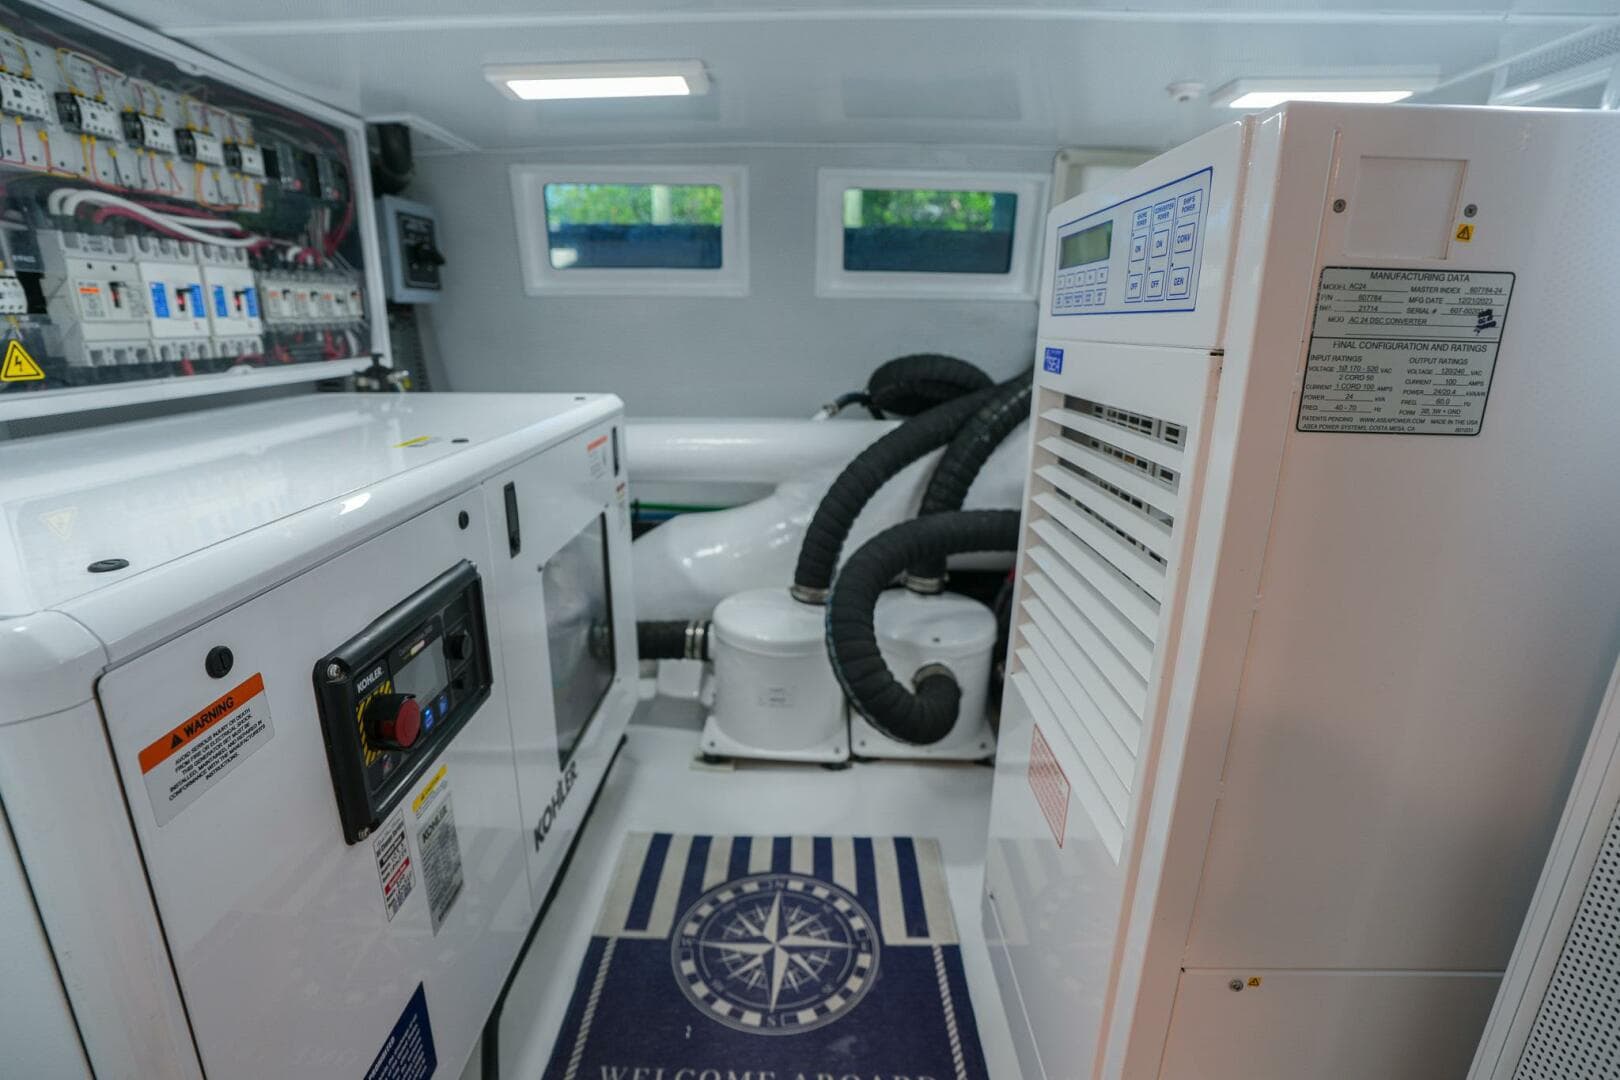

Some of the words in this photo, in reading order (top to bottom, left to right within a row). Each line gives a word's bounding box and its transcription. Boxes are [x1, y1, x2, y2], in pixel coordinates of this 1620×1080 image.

[1156, 240, 1163, 248] ON
[1177, 233, 1191, 244] CONV
[1151, 280, 1159, 288] OFF
[1370, 271, 1446, 281] MANUFACTURING
[1446, 274, 1470, 282] DATA
[1332, 340, 1358, 348] FINAL
[1359, 341, 1430, 350] CONFIGURATION
[1431, 343, 1449, 351] AND
[1450, 344, 1487, 352] RATINGS
[357, 666, 382, 693] KOHLER
[184, 697, 233, 736] WARNING
[175, 760, 190, 772] FROM
[191, 751, 201, 761] FIRE
[203, 745, 209, 753] OR
[210, 726, 236, 747] ELECTRICAL
[176, 751, 190, 764] AVOID
[191, 736, 212, 753] SERIOUS
[213, 724, 228, 737] INJURY
[229, 718, 236, 726] OR
[236, 708, 250, 721] DEATH
[228, 739, 236, 749] AND
[237, 724, 257, 741] REPAIRED
[182, 765, 193, 774] THIS
[194, 743, 222, 766] GENERATOR
[223, 736, 231, 745] SET
[232, 726, 243, 738] MUST
[169, 769, 206, 800] CONFORMANCE
[207, 759, 219, 771] WITH
[219, 752, 228, 761] THE
[534, 760, 578, 853] KOHLER
